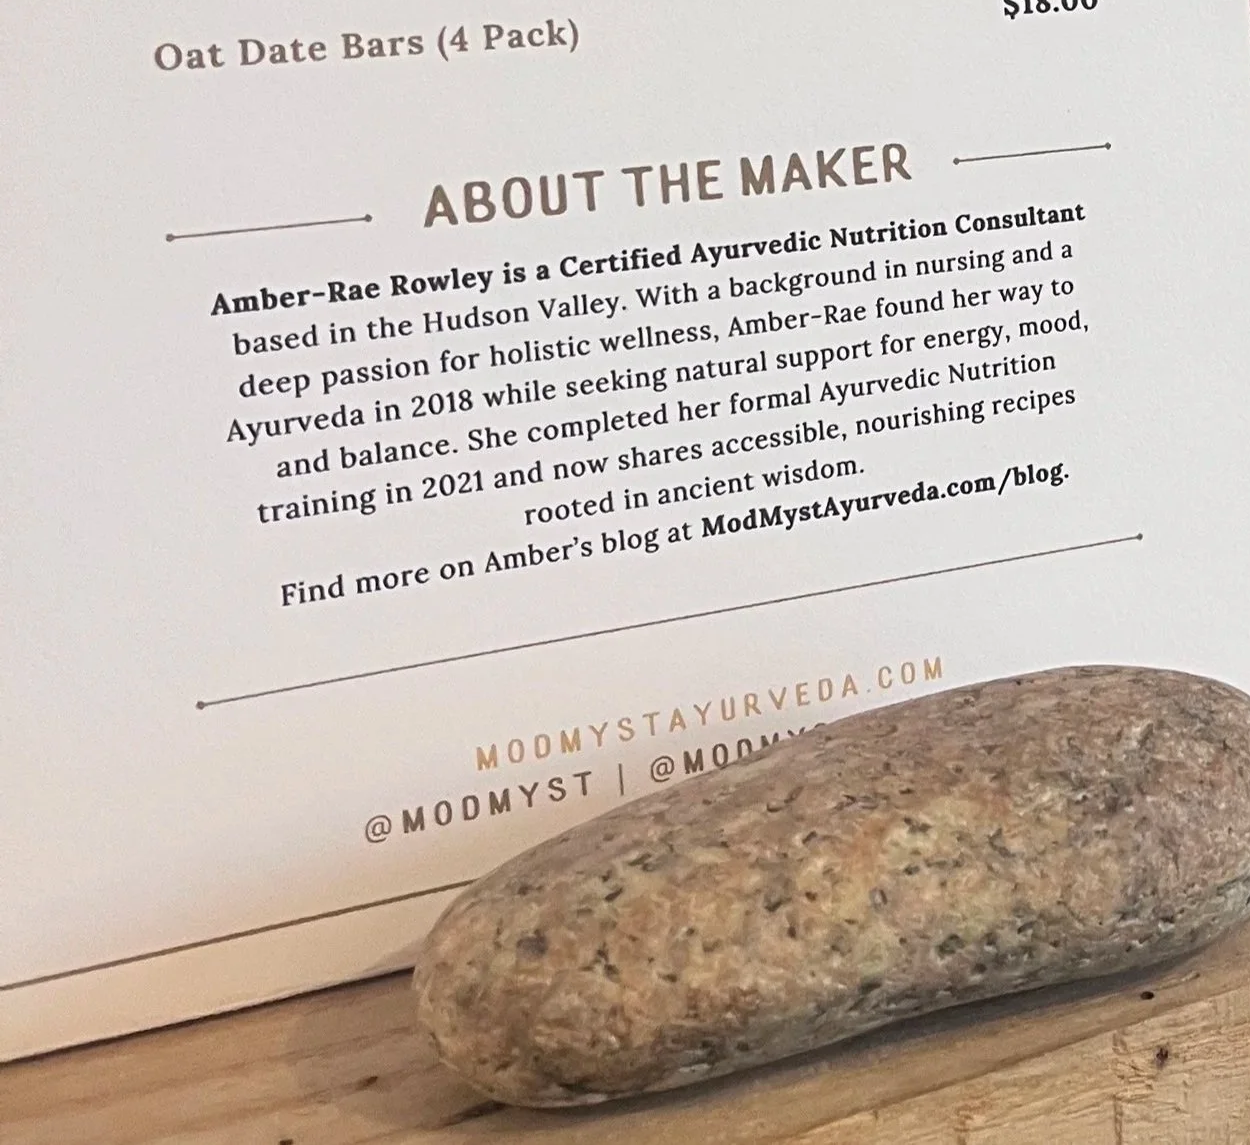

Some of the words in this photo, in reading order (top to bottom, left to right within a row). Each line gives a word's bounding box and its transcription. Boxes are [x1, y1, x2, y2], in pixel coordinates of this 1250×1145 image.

[154, 43, 225, 71] Oat
[238, 39, 327, 66] Date
[341, 33, 424, 59] Bars
[437, 26, 468, 61] (4
[483, 18, 578, 53] Pack)
[424, 170, 604, 228] ABOUT
[621, 160, 723, 207] THE
[740, 143, 912, 196] MAKER
[211, 281, 380, 316] Amber-Rae
[390, 267, 494, 296] Rowley
[502, 262, 526, 284] is
[536, 264, 551, 281] a
[560, 244, 682, 278] Certified
[690, 230, 822, 268] Ayurvedic
[829, 219, 948, 248] Nutrition
[955, 204, 1086, 234] Consultant
[239, 374, 310, 398] deep
[321, 358, 430, 395] passion
[440, 349, 480, 373] for
[489, 336, 591, 367] holistic
[599, 325, 719, 352] wellness,
[728, 305, 866, 337] Amber-Rae
[875, 290, 944, 318] found
[951, 288, 991, 309] her
[998, 284, 1043, 305] way
[1051, 279, 1074, 296] to
[257, 488, 376, 523] training
[386, 482, 413, 504] in
[422, 470, 484, 499] 2021
[494, 460, 544, 489] and
[553, 457, 609, 480] now
[618, 444, 702, 470] shares
[712, 420, 847, 456] accessible,
[856, 400, 985, 435] nourishing
[992, 390, 1075, 415] recipes
[277, 448, 330, 478] and
[339, 439, 458, 469] balance.
[468, 427, 518, 451] She
[528, 403, 669, 442] completed
[677, 400, 721, 422] her
[729, 383, 811, 415] formal
[820, 368, 940, 406] Ayurvedic
[948, 354, 1056, 384] Nutrition
[281, 574, 345, 606] Find
[356, 567, 430, 594] more
[440, 560, 475, 580] on
[601, 528, 659, 553] blog
[668, 522, 693, 543] at
[701, 463, 1069, 538] ModMystAyurveda.com/blog.
[524, 490, 615, 525] rooted
[624, 489, 649, 510] in
[658, 473, 755, 505] ancient
[762, 456, 864, 487] wisdom.
[475, 656, 945, 771] MODMYSTAYURVEDA.COM
[365, 770, 593, 844] @MODMYST
